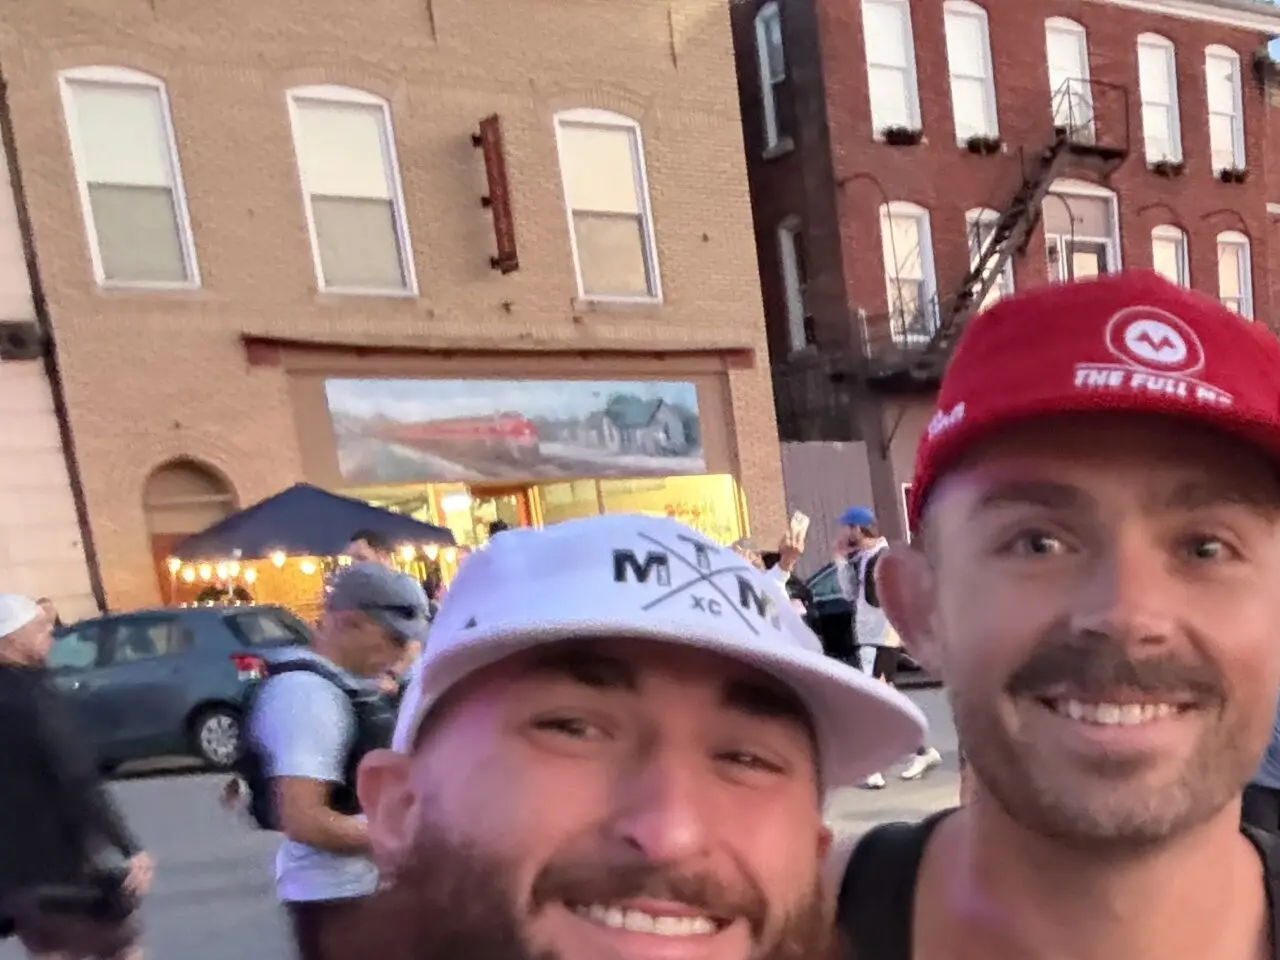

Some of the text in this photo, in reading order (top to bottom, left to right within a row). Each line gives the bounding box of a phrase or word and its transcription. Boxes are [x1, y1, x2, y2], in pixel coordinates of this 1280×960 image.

[1074, 367, 1125, 388] THE
[1130, 372, 1188, 398] FULL
[690, 592, 723, 616] XC
